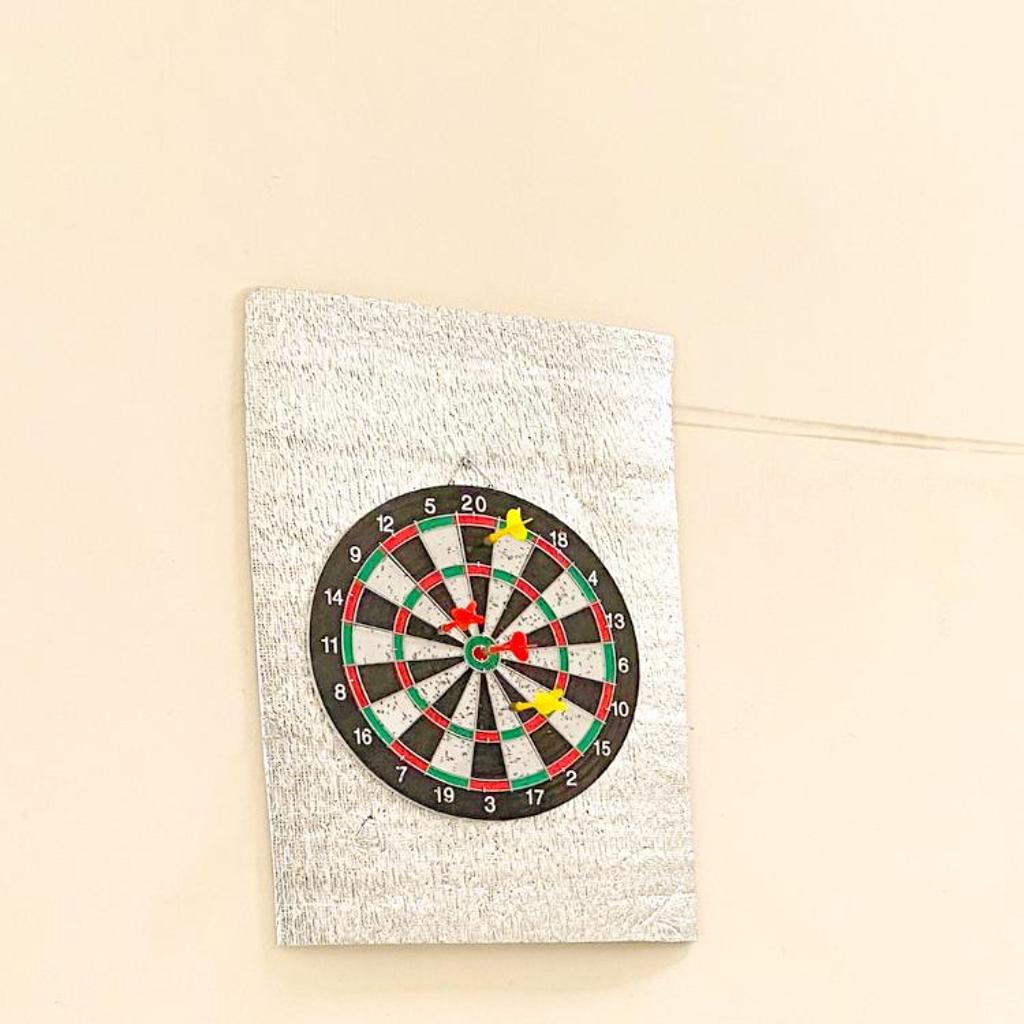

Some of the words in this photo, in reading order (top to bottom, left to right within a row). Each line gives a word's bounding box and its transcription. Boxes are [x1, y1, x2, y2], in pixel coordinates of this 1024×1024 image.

[424, 497, 436, 513] 5
[461, 494, 487, 512] 20
[376, 515, 394, 533] 12
[549, 531, 569, 547] 18
[349, 547, 361, 563] 9
[588, 571, 599, 586] 4
[324, 589, 343, 605] 14
[606, 613, 625, 629] 13
[321, 637, 338, 654] 11
[618, 657, 629, 673] 6
[334, 684, 347, 701] 8
[609, 701, 629, 717] 10
[353, 728, 373, 745] 16
[594, 741, 612, 757] 15
[396, 766, 408, 783] 7
[566, 769, 577, 786] 2
[433, 786, 455, 803] 19
[525, 788, 545, 805] 17
[483, 795, 497, 812] 3
